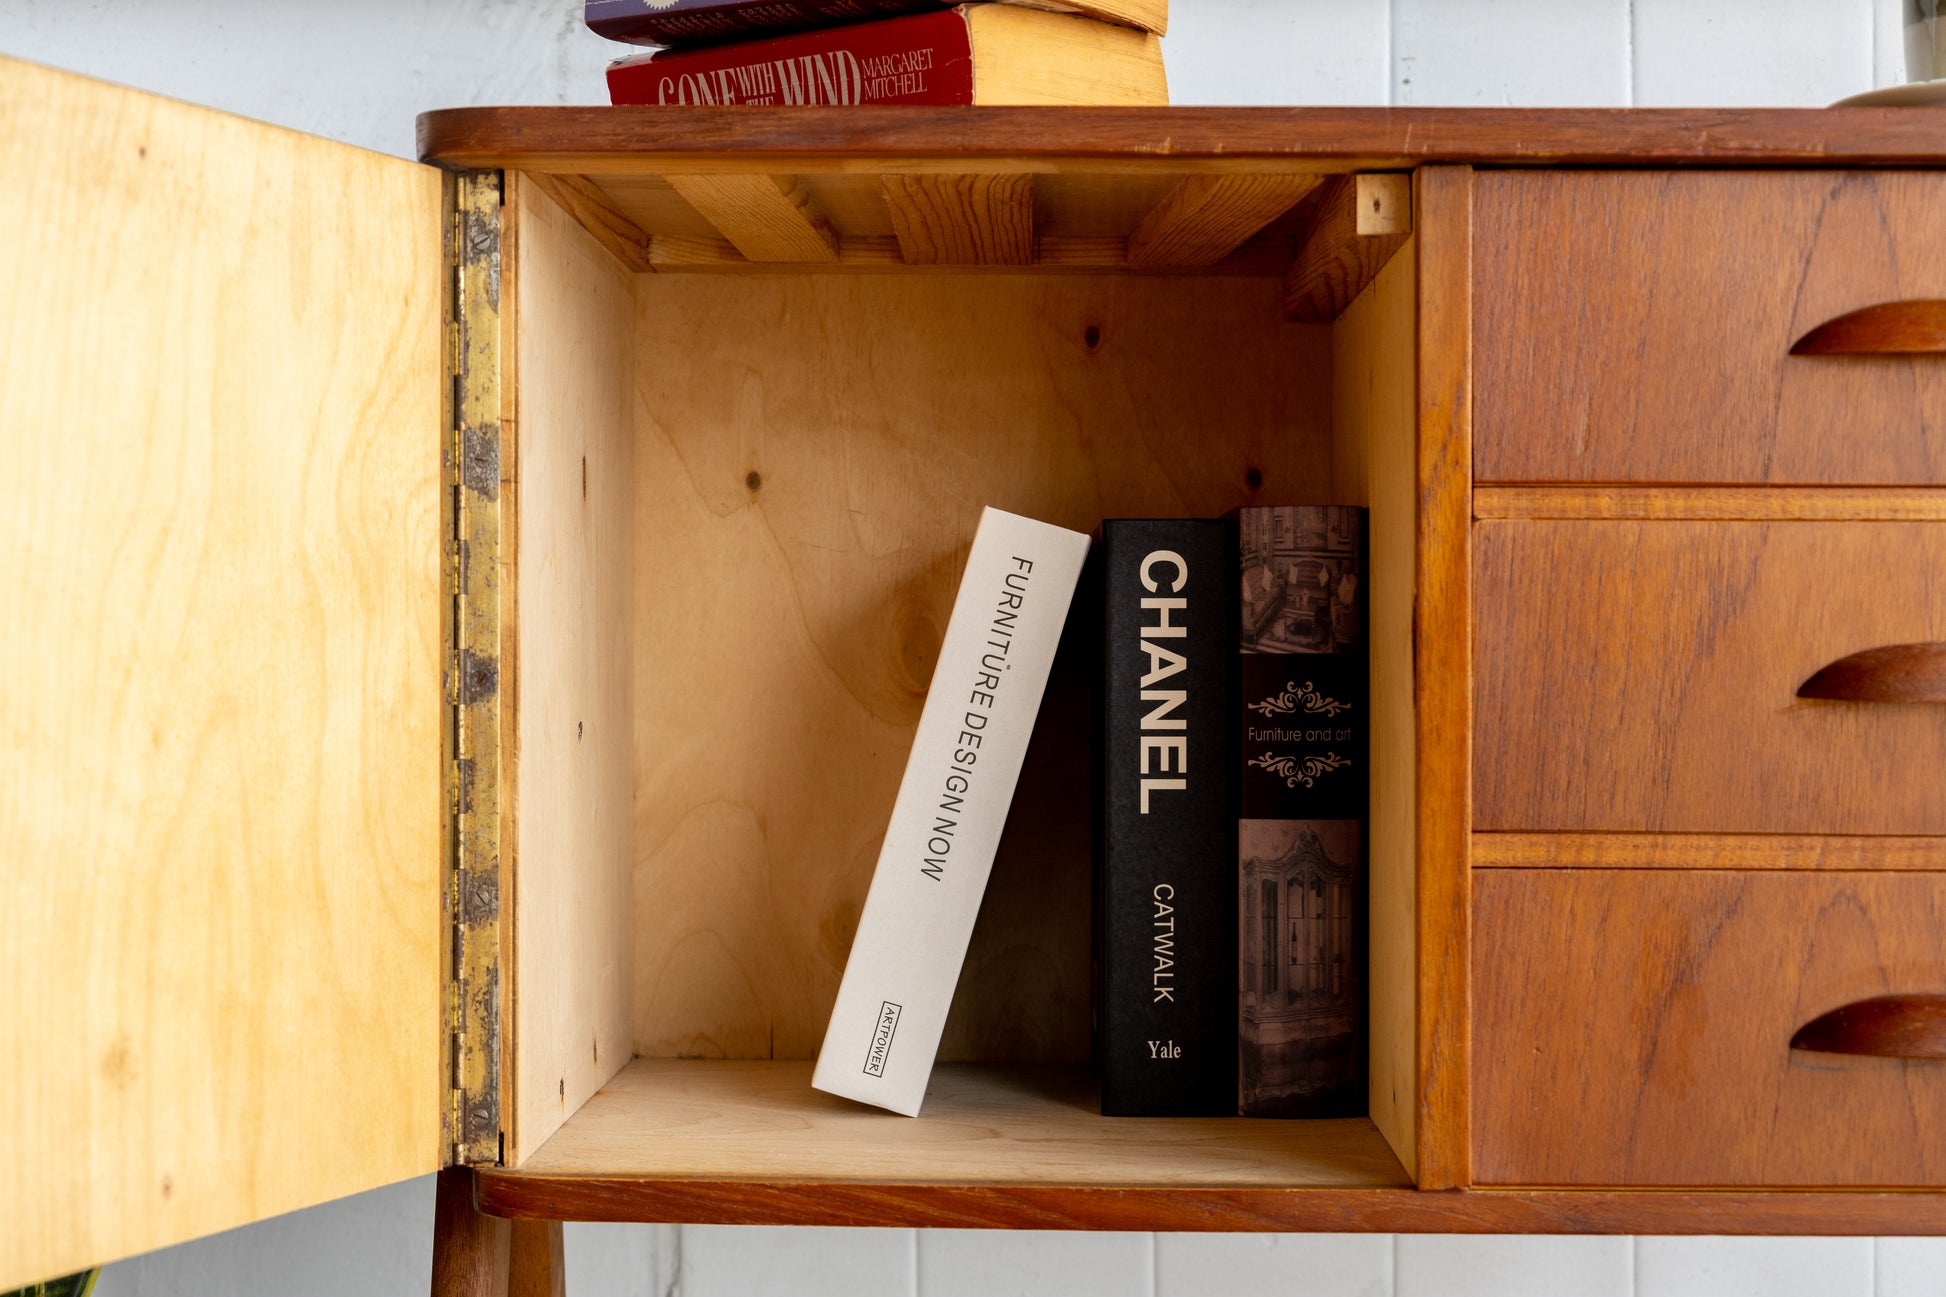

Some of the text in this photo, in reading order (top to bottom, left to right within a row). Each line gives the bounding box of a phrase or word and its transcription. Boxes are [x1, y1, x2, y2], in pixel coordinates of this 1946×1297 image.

[735, 62, 776, 97] WITH
[774, 50, 861, 106] WIND
[862, 48, 933, 79] MARGARET
[864, 72, 927, 100] MITCHELL
[1139, 549, 1188, 814] CHANEL
[920, 556, 1034, 882] FURNITURE DESIGN NOW
[1248, 726, 1351, 742] Furniture and art
[1153, 883, 1175, 1003] CATWALK
[868, 1006, 895, 1072] ARTPOWER
[1147, 1039, 1181, 1059] Yale
